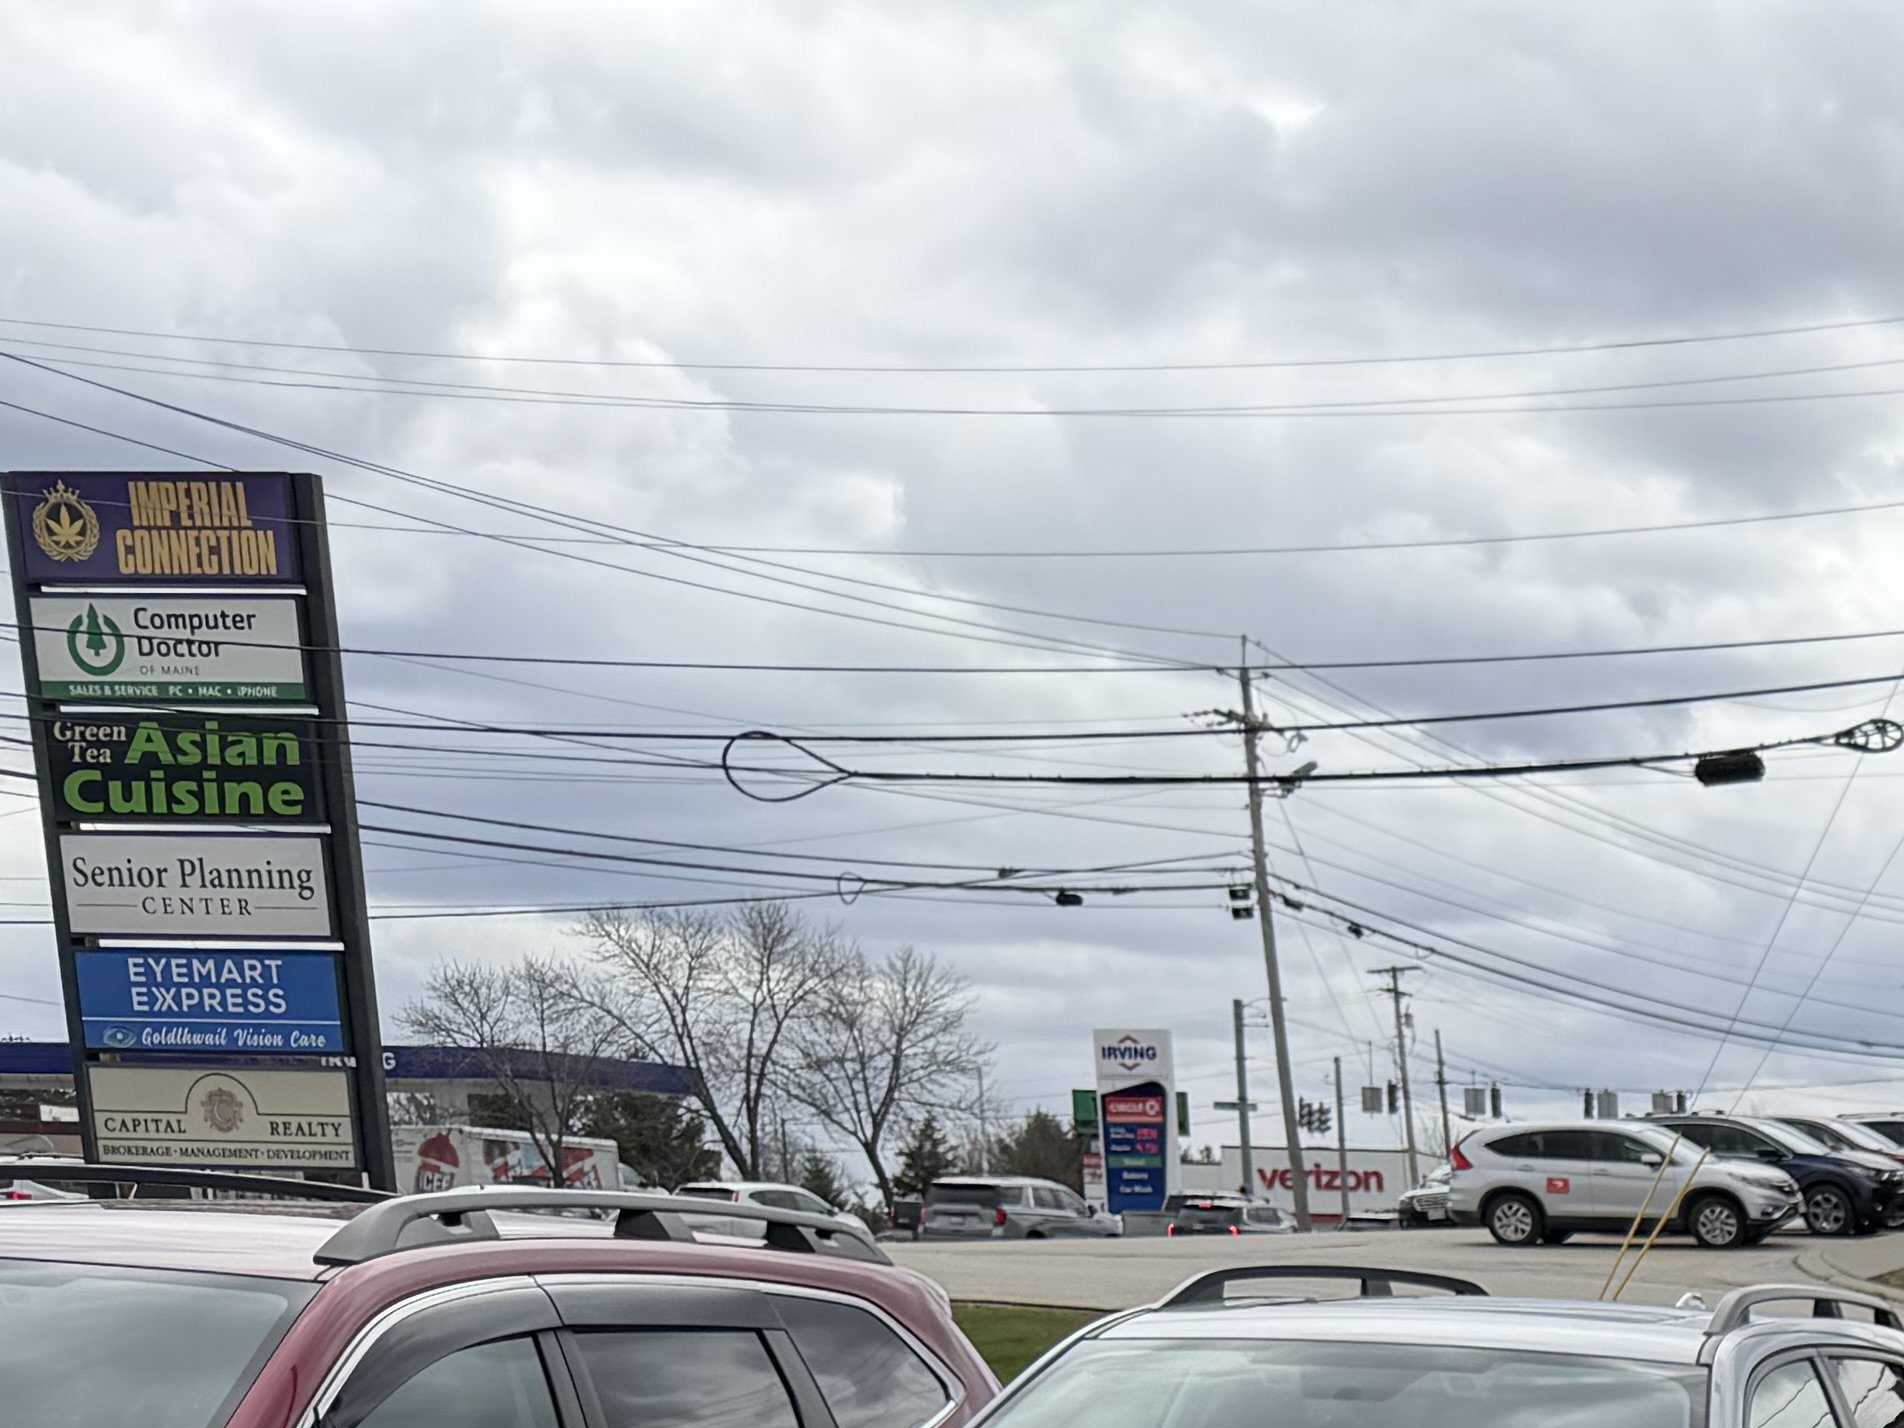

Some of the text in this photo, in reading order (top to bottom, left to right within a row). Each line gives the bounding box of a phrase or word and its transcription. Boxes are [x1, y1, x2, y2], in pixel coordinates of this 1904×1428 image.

[128, 481, 252, 527] IMPERIAL
[116, 529, 277, 575] CONNECTION
[134, 608, 256, 638] Computer
[137, 636, 223, 657] Doctor
[140, 665, 200, 676] OF MAINE
[69, 684, 100, 696] SALES
[114, 684, 158, 696] SERVICE
[169, 685, 182, 696] PC
[199, 685, 221, 696] MAC
[53, 721, 127, 741] Green
[68, 742, 112, 763] Tea
[124, 720, 300, 765] Asian
[63, 769, 305, 815] Cuisine
[72, 856, 314, 900] Senior Planning
[142, 897, 252, 916] CENTER
[127, 957, 282, 985] EYEMART
[131, 987, 287, 1014] EXPRESS
[233, 1028, 284, 1047] Vision
[290, 1030, 327, 1048] Care
[1101, 1046, 1157, 1060] IRVING
[104, 1117, 342, 1138] CAPITAL REALTY
[103, 1144, 350, 1161] BROKERAGE MANAGEMENT DEVELOPMENT
